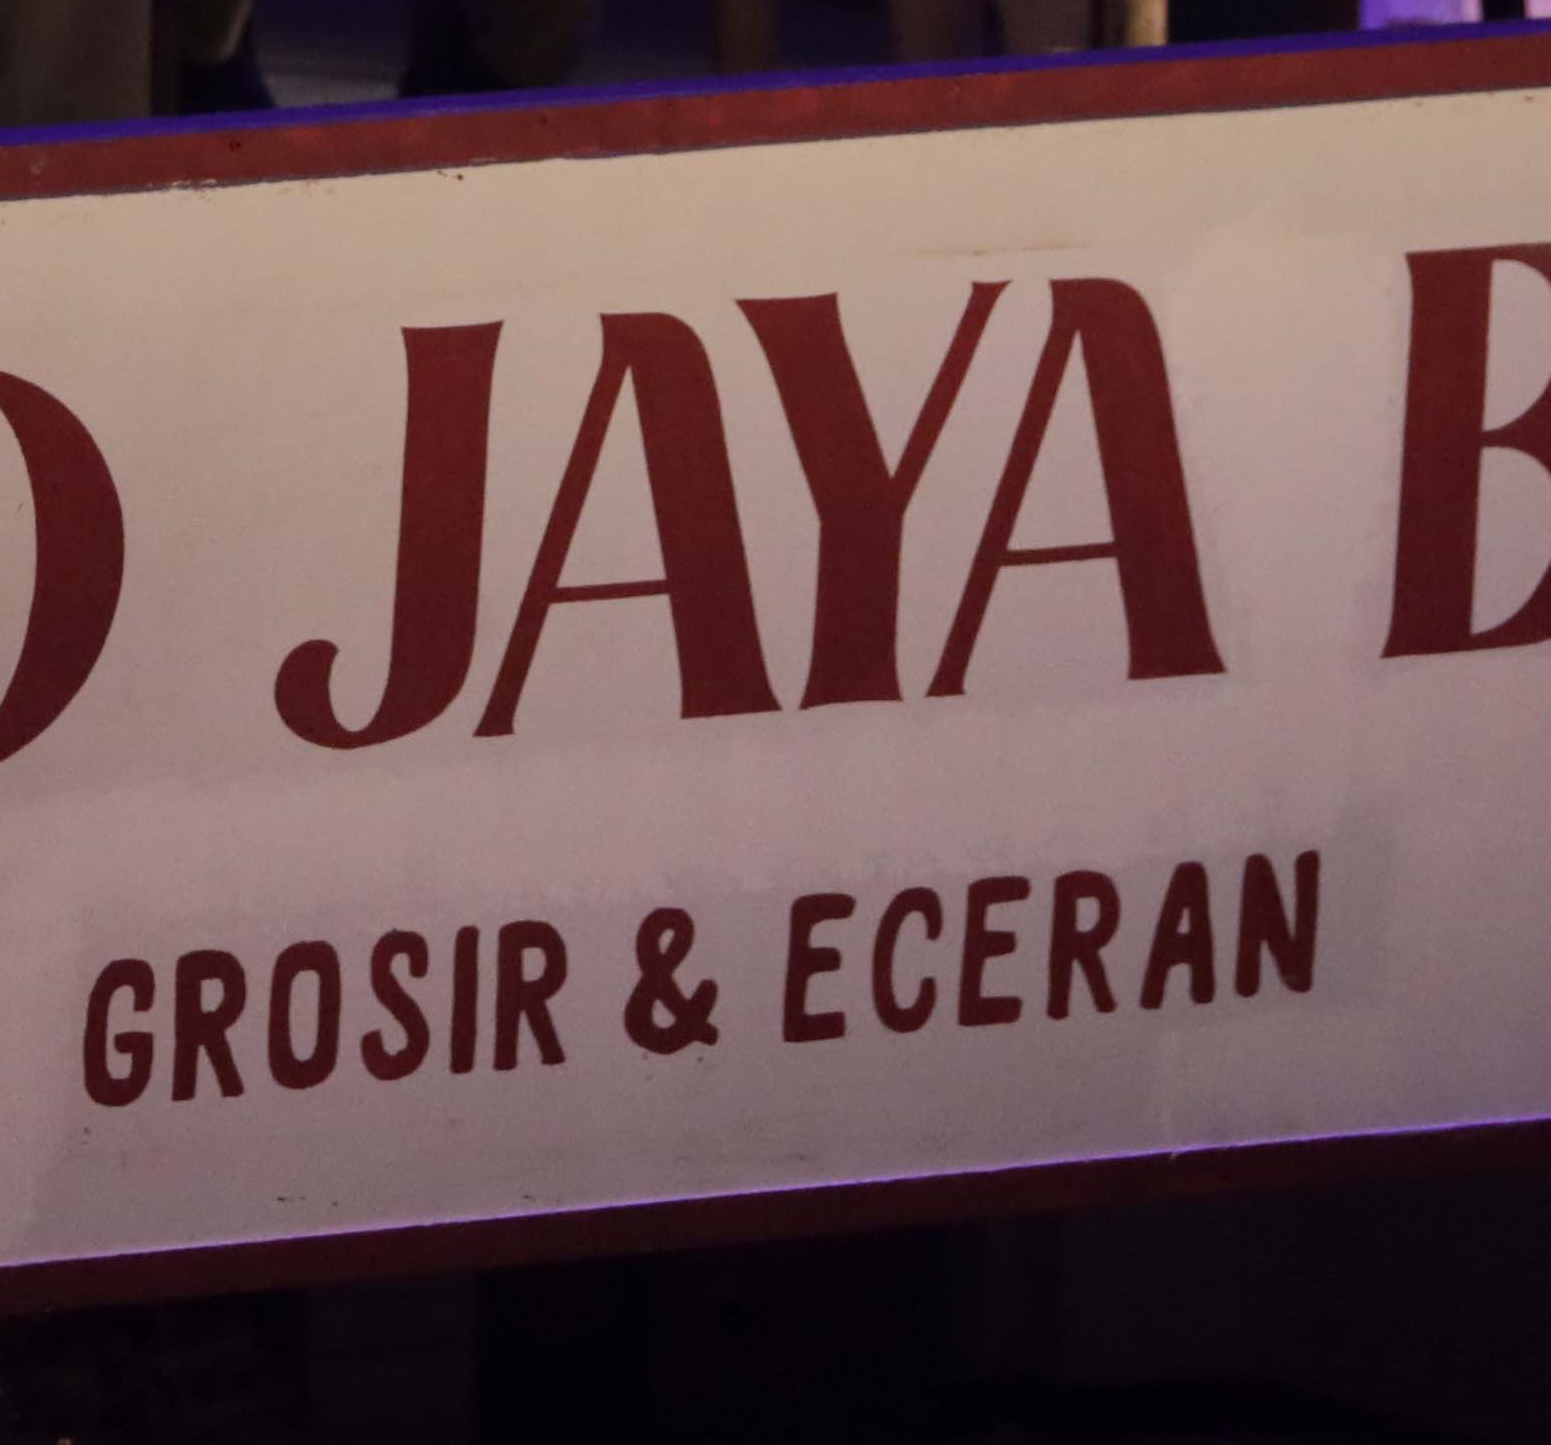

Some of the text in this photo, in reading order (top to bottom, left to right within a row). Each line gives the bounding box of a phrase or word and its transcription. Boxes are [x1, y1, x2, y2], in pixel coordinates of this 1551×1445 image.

[274, 278, 1226, 750] JAYA
[83, 850, 1321, 1107] GROSIR & ECERAN
